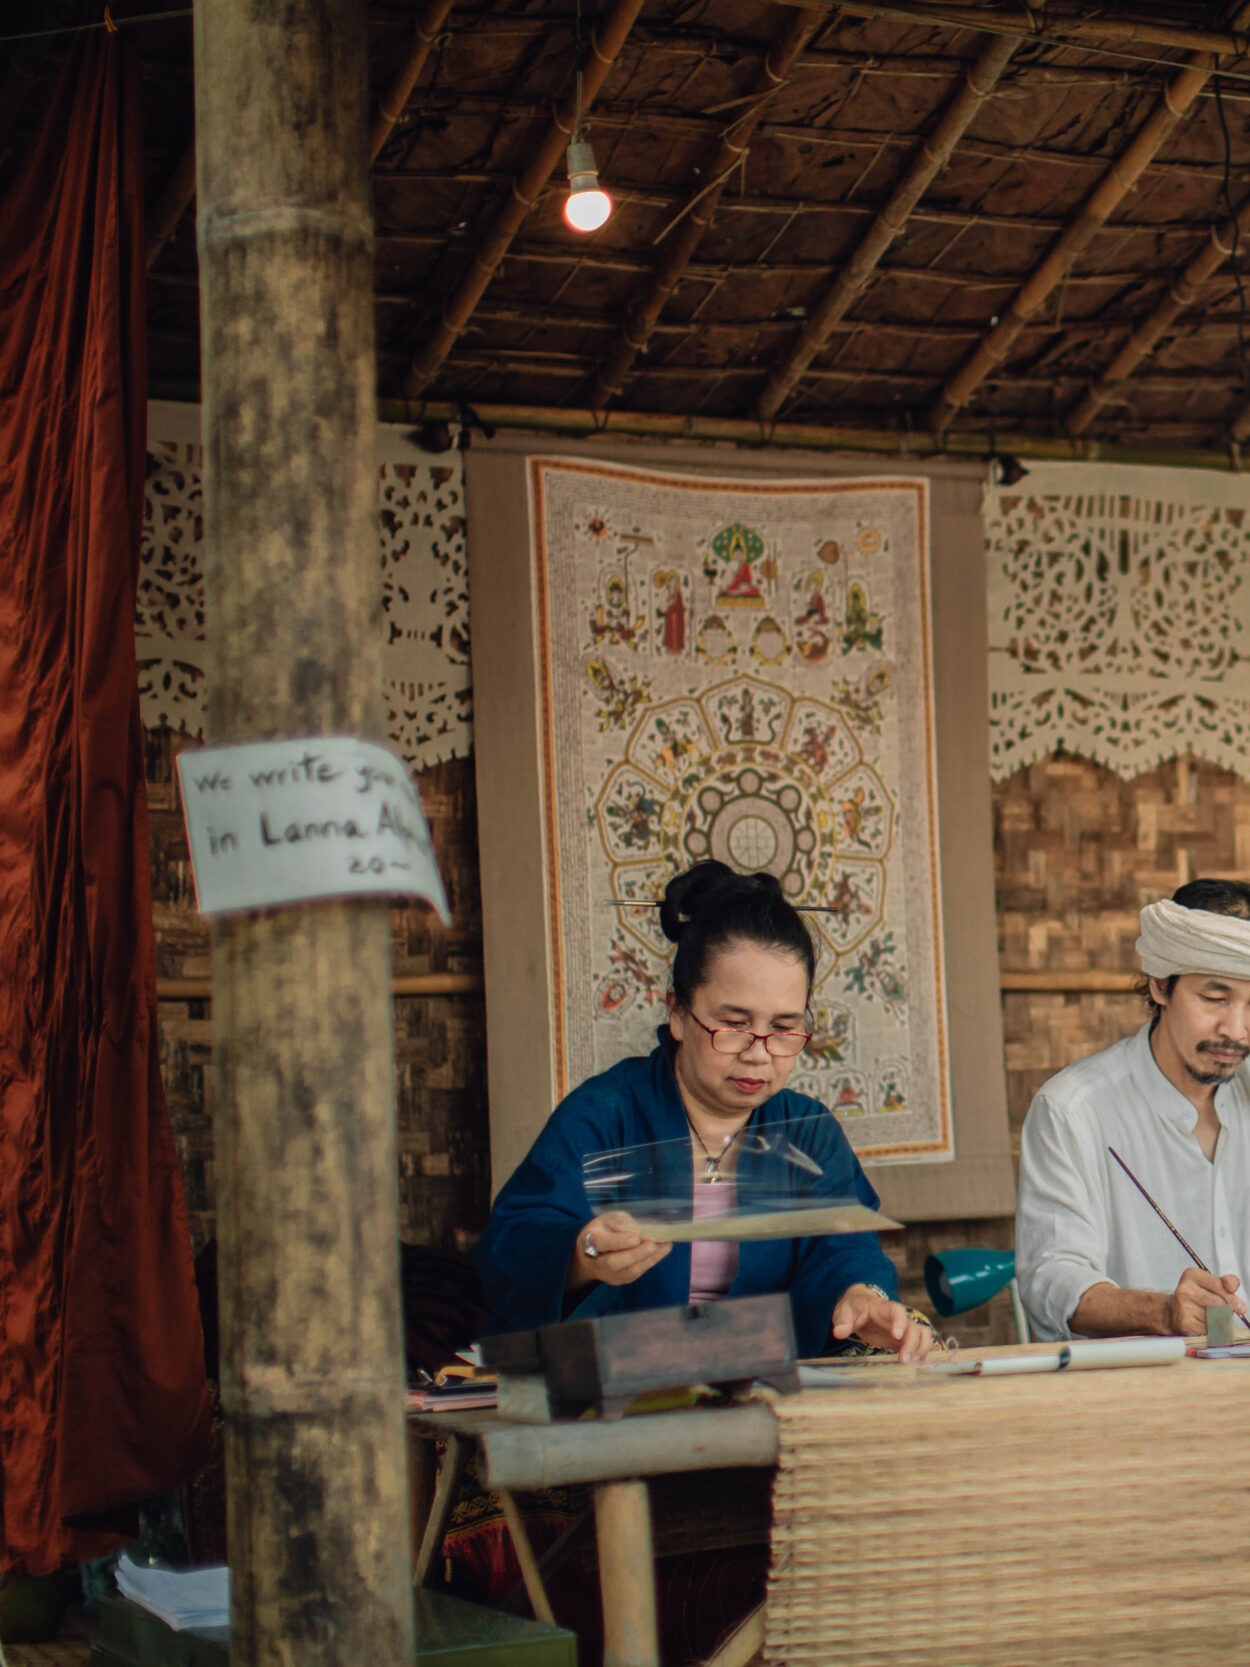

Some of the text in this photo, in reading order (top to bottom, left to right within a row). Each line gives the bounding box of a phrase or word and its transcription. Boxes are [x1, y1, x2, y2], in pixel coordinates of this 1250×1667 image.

[249, 752, 341, 789] write
[207, 827, 238, 856] in
[259, 811, 366, 847] Lanna
